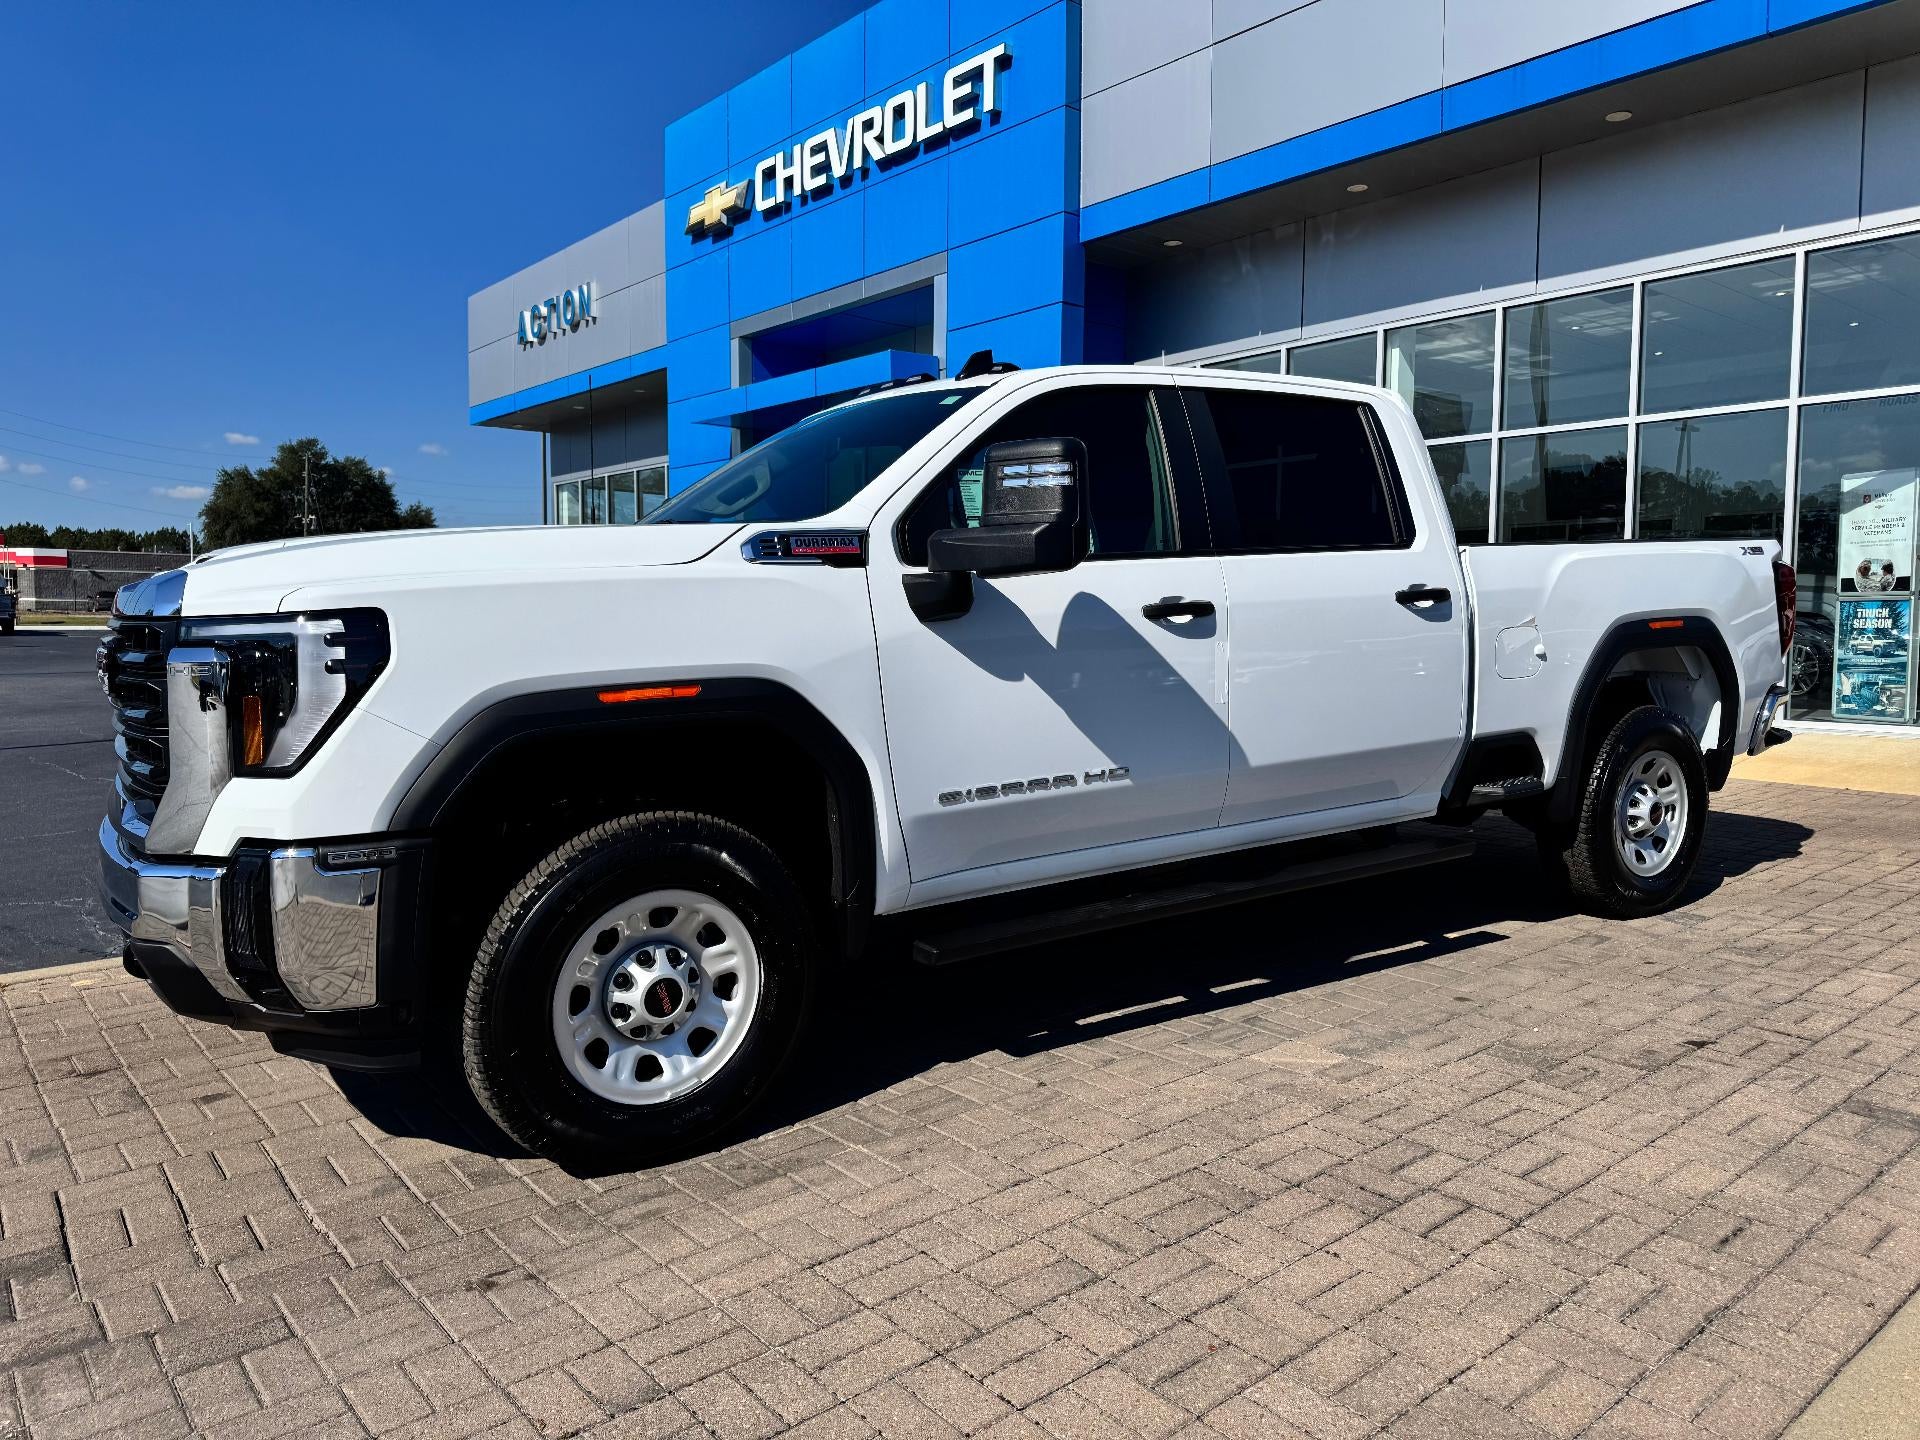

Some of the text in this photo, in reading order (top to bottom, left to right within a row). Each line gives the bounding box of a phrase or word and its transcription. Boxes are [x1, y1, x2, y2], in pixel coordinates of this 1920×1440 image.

[755, 42, 1008, 212] CHEVROLET
[517, 281, 595, 347] ACTION
[794, 537, 856, 548] DURAMAX
[1853, 618, 1893, 629] SEASON
[1856, 607, 1890, 618] TRUCK
[938, 766, 1130, 807] SIERRA HD
